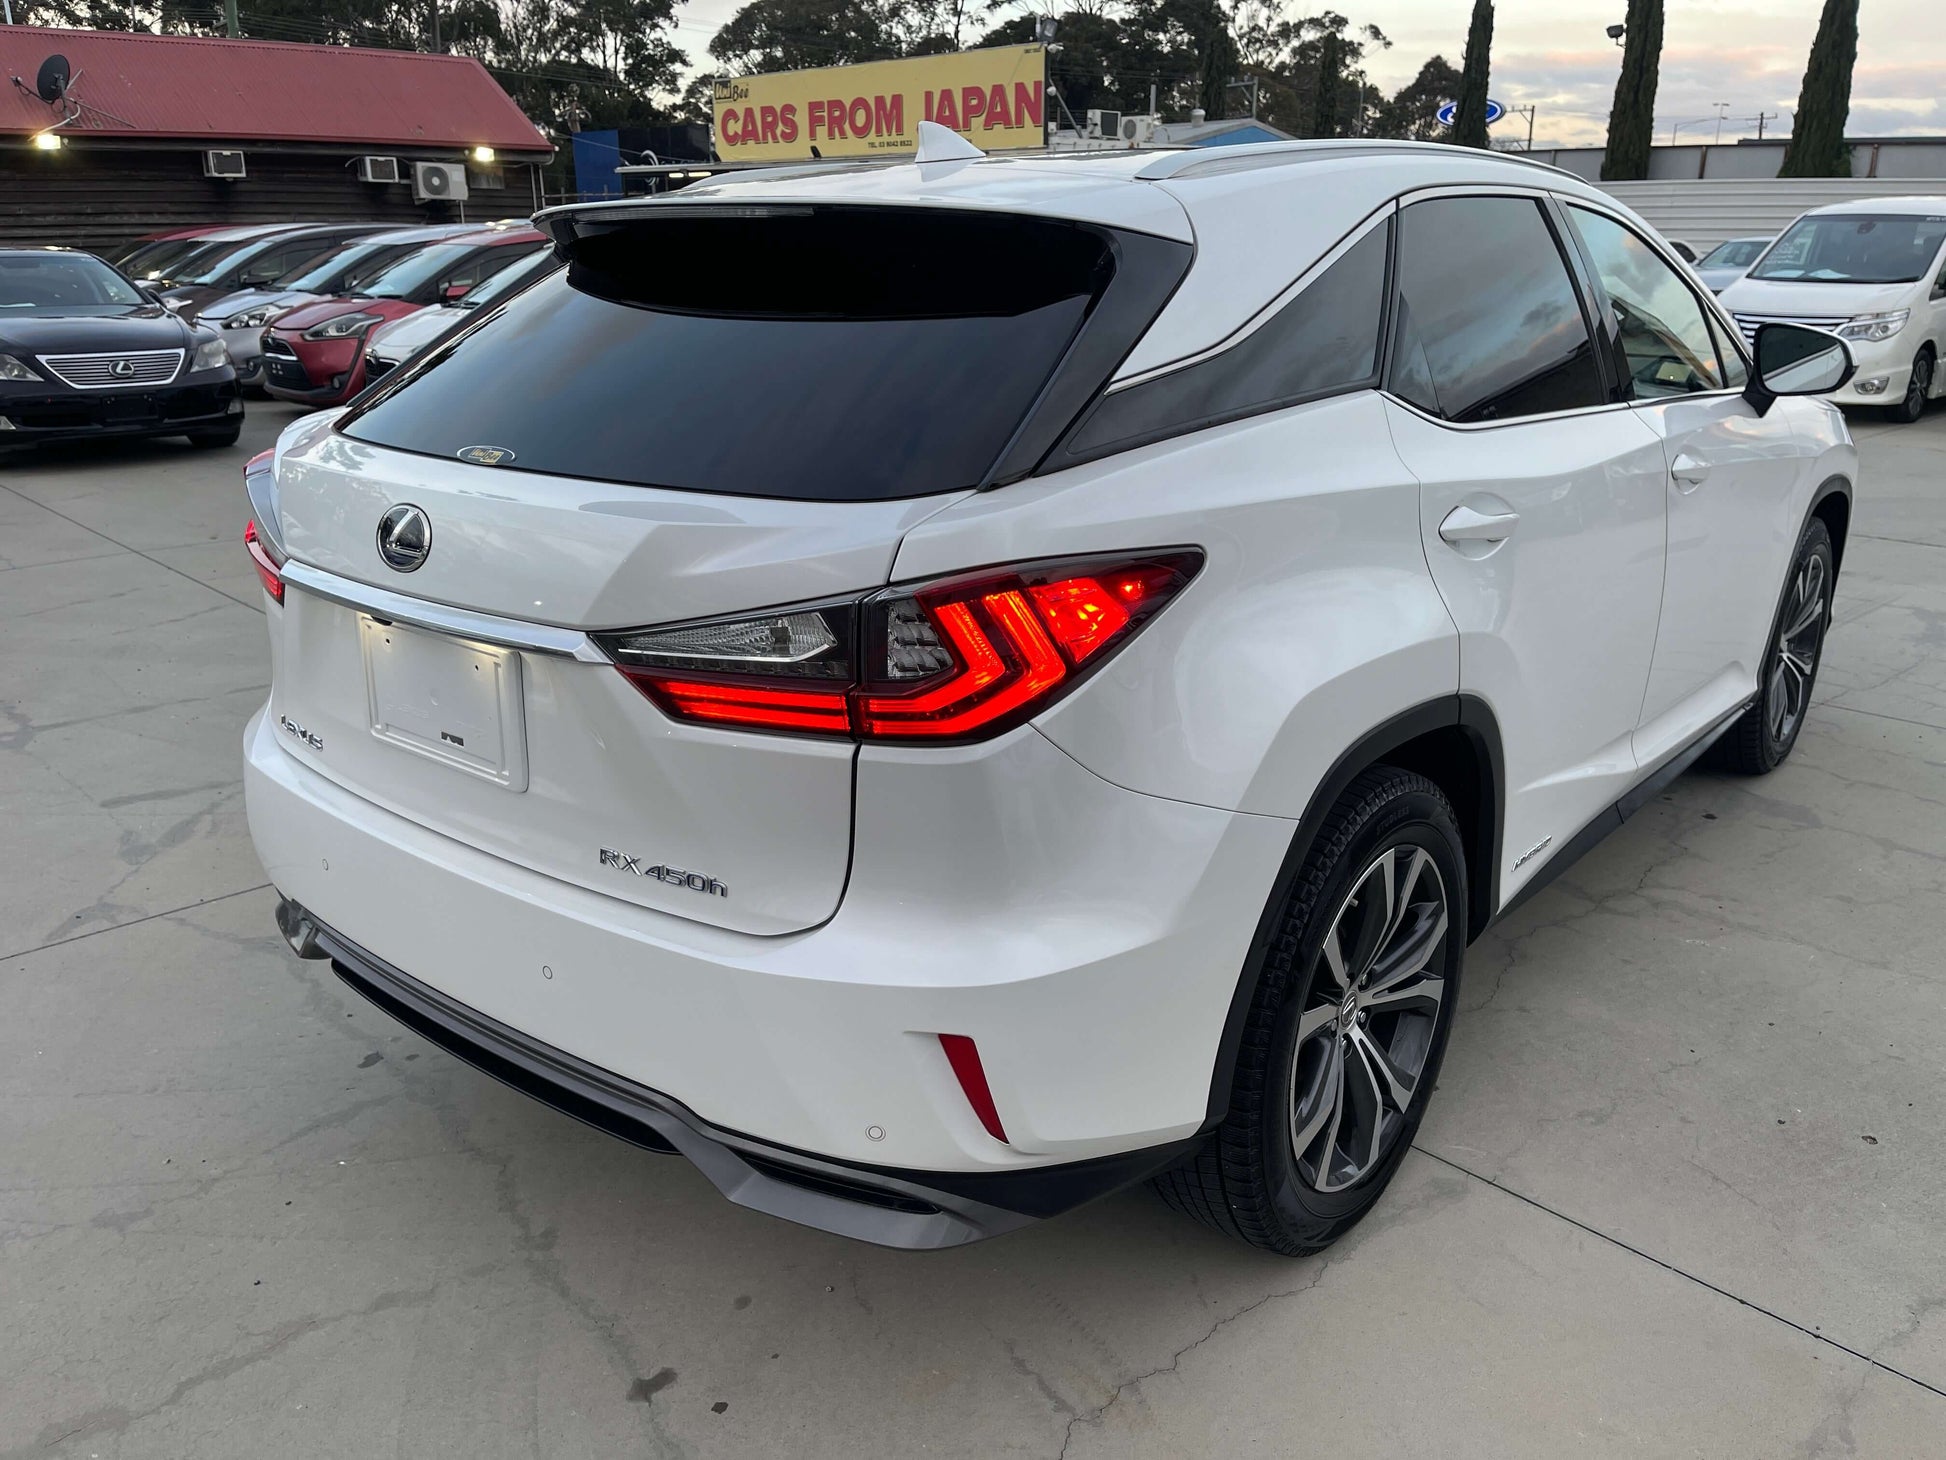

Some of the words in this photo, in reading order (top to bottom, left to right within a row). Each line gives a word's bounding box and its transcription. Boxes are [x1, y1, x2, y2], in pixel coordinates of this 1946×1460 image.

[721, 103, 798, 146] CARS
[808, 94, 904, 141] FROM
[600, 847, 642, 876] RX
[644, 863, 728, 898] 450h
